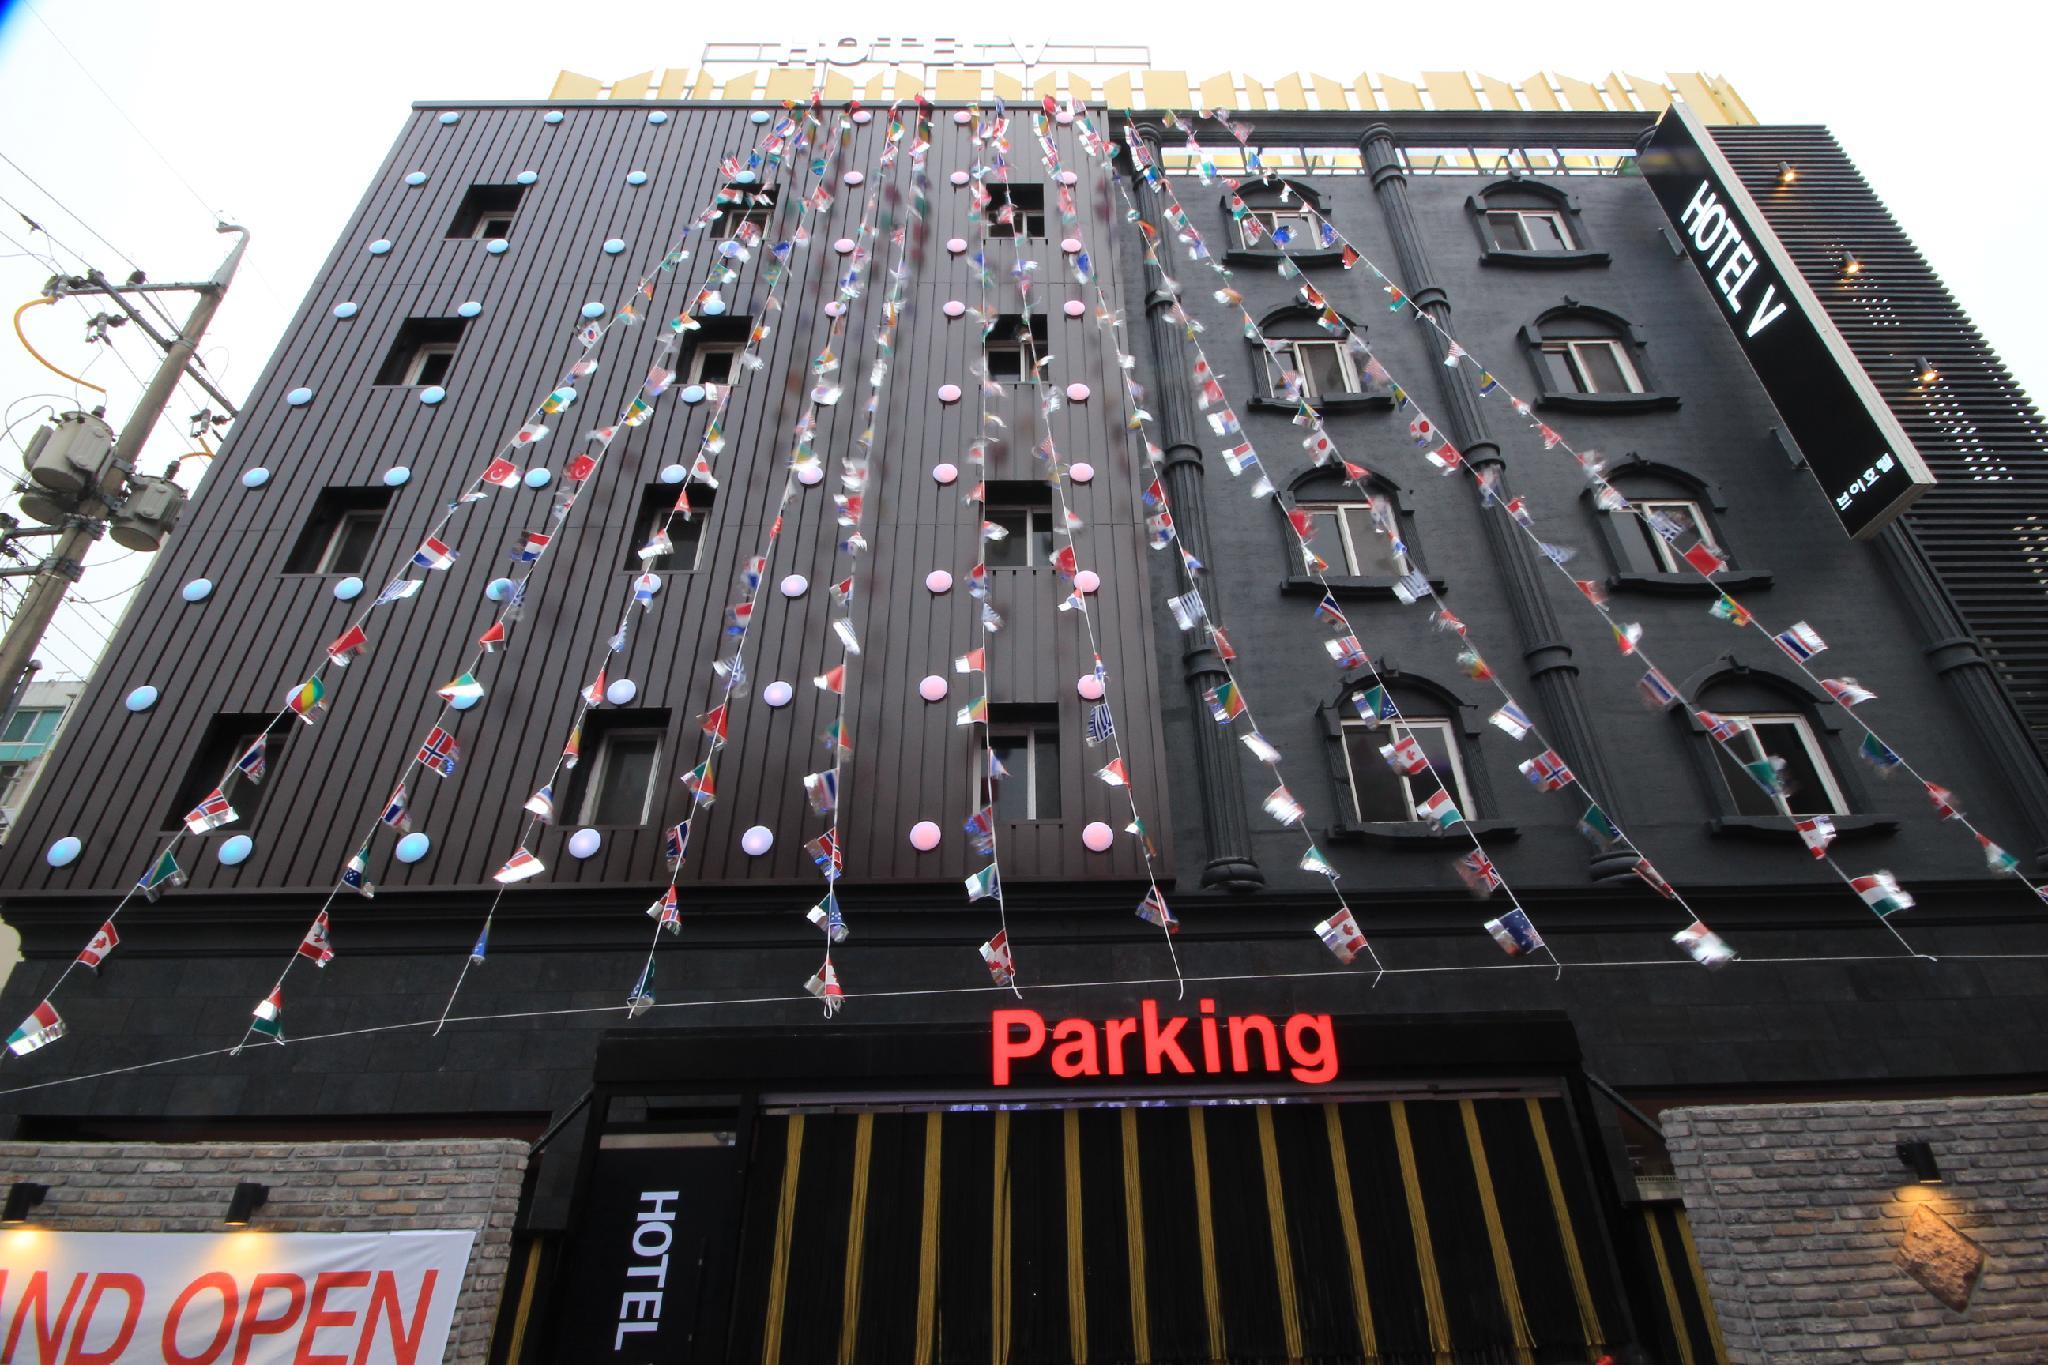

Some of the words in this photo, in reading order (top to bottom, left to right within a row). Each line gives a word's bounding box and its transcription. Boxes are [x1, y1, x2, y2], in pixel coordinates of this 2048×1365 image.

[1681, 180, 1759, 314] HOTEL
[1747, 285, 1786, 338] V
[992, 999, 1339, 1087] Parking
[0, 1269, 145, 1365] ND
[162, 1271, 438, 1365] OPEN
[614, 1190, 680, 1351] HOTEL
